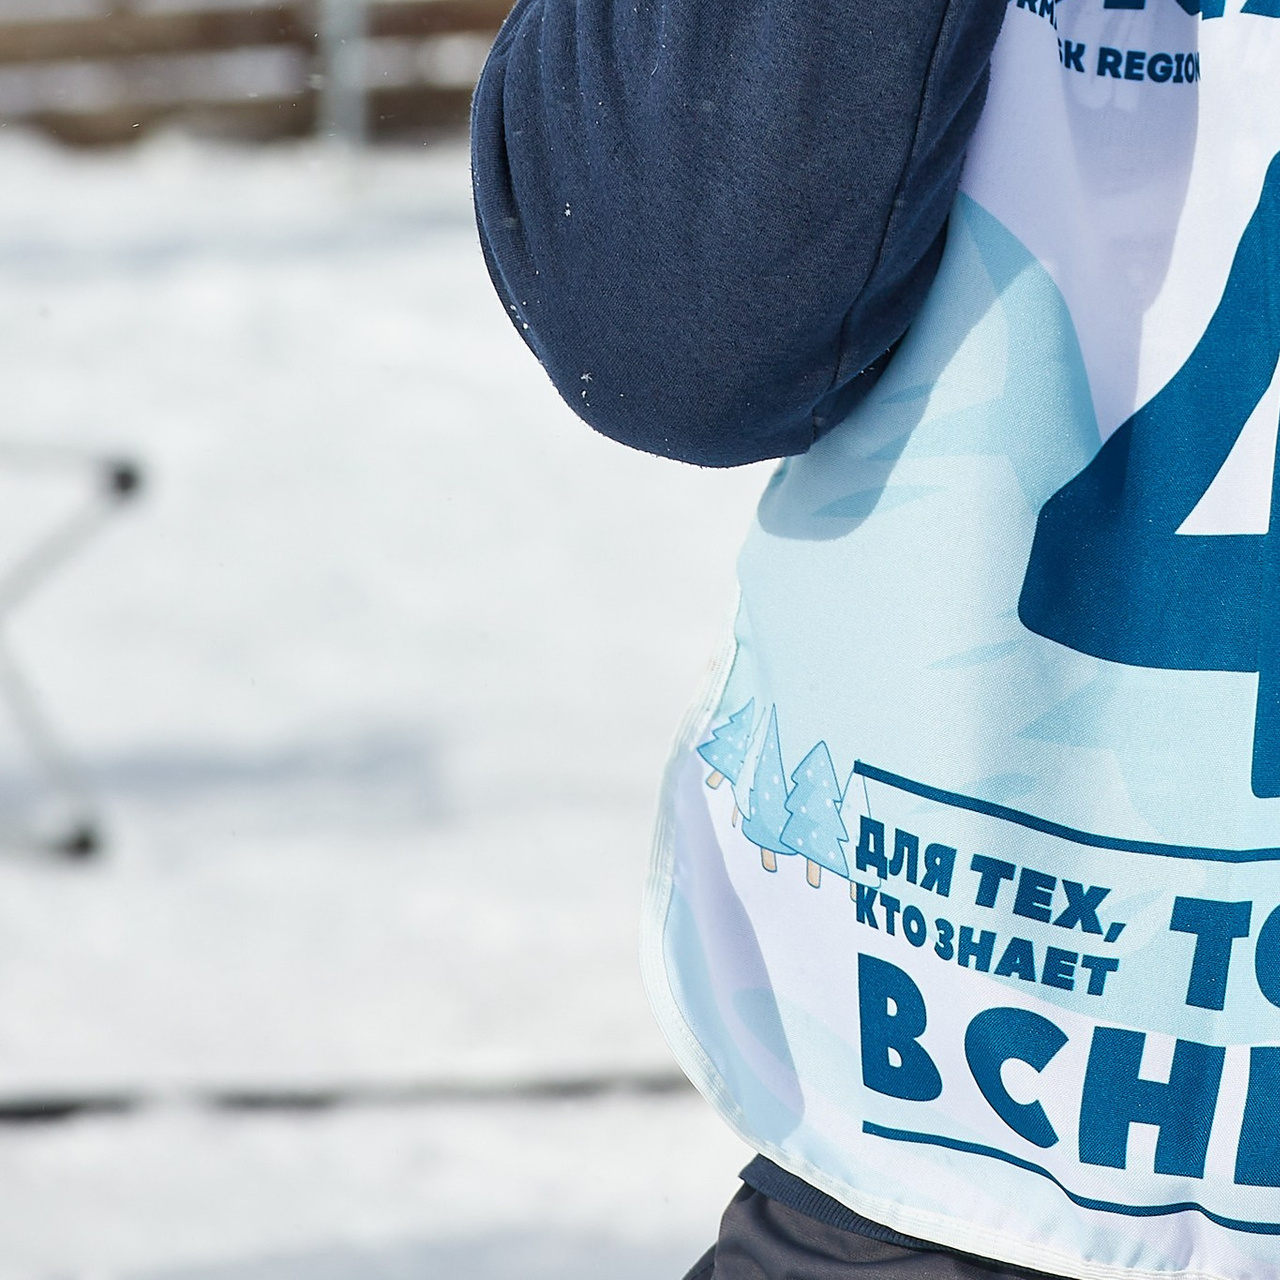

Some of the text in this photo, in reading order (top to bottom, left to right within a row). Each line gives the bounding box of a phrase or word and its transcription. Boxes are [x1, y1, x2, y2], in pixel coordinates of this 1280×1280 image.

[855, 814, 1127, 943] ДЛЯ ТЕХ,
[855, 882, 1120, 997] КТО ЗНАЕТ
[857, 952, 943, 1102] В
